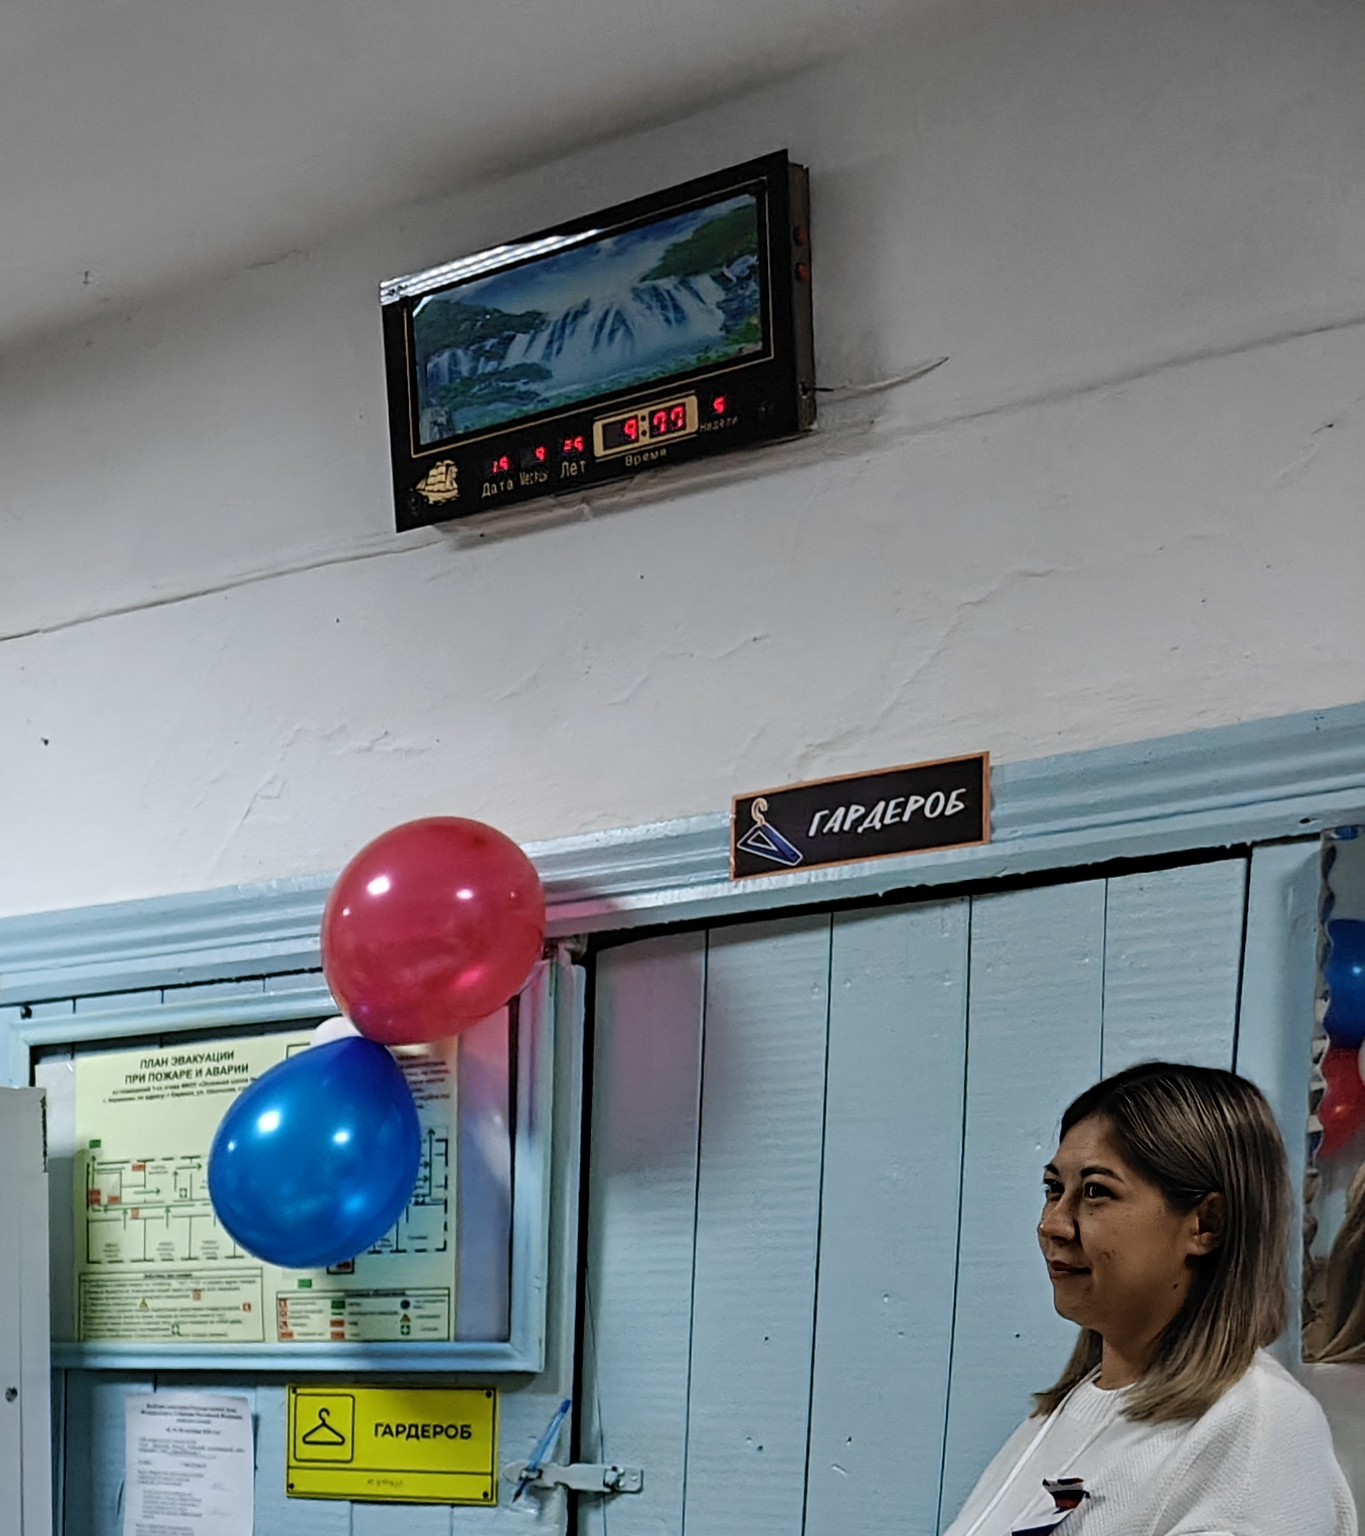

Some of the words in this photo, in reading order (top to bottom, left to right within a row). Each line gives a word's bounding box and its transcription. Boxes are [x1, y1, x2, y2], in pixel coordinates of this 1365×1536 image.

[625, 448, 667, 466] Время
[482, 479, 514, 498] Дата
[560, 460, 586, 478] Лет
[808, 788, 967, 837] ГАРДЕРОБ
[140, 1058, 168, 1069] ПЛАН
[171, 1050, 235, 1067] ЭВАКУАЦИИ
[125, 1074, 146, 1085] ПРИ
[148, 1068, 193, 1083] ПОЖАРЕ
[195, 1067, 203, 1078] И
[206, 1063, 249, 1077] АВАРИИ
[374, 1422, 473, 1441] ГАРДЕРОБ
